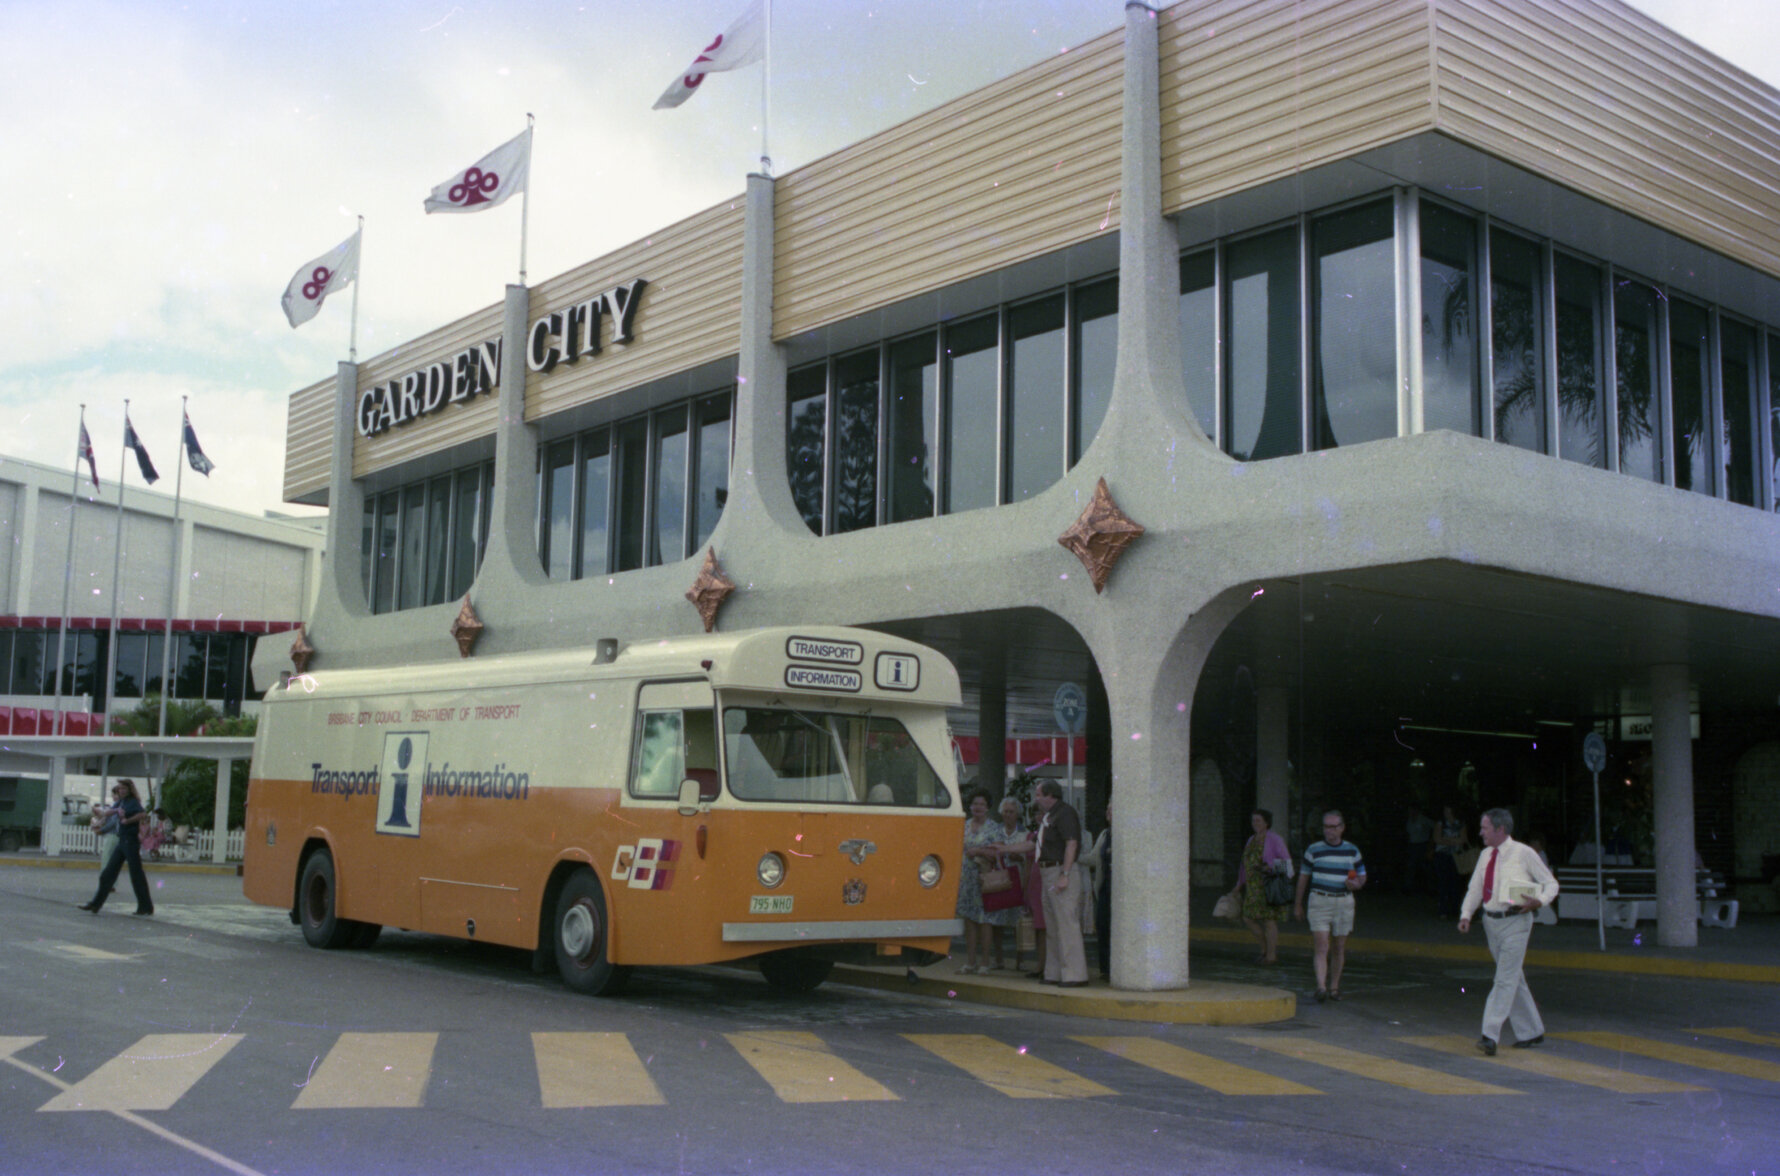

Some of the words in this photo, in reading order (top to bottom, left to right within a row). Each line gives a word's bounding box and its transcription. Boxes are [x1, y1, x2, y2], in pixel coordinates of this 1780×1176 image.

[357, 336, 502, 436] GARDEN
[527, 279, 648, 373] CITY
[794, 642, 856, 659] TRANSPORT
[790, 670, 857, 687] INFORMATION
[328, 711, 355, 725] BRISBANE
[358, 711, 372, 724] CITY
[375, 710, 402, 724] COUNCIL
[411, 707, 456, 722] DEPARTMENT
[459, 707, 472, 721] OF
[475, 704, 521, 720] TRANSPORT
[311, 763, 378, 801] Transport
[425, 762, 530, 800] Information
